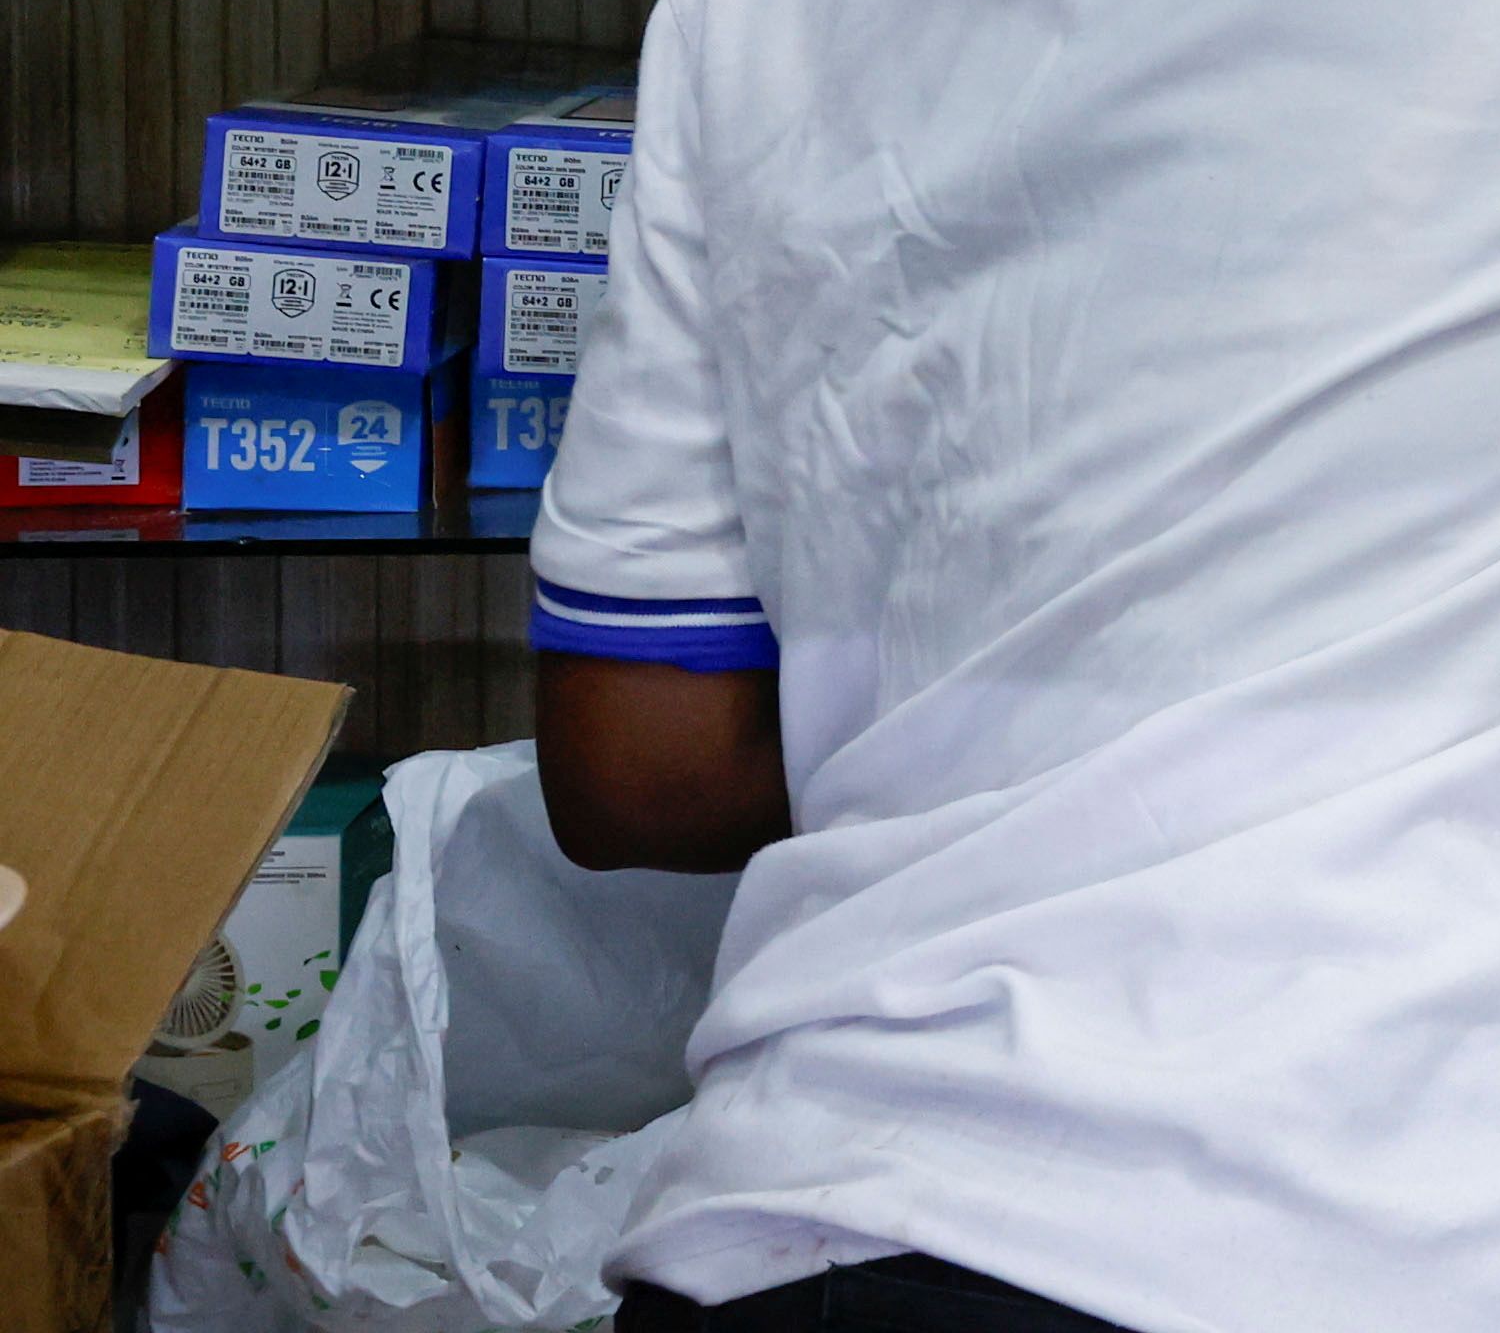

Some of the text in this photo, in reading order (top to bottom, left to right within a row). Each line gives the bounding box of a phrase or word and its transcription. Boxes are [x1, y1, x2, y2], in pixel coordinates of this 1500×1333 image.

[276, 160, 292, 169] GB
[350, 416, 388, 439] 24
[201, 416, 316, 471] T352
